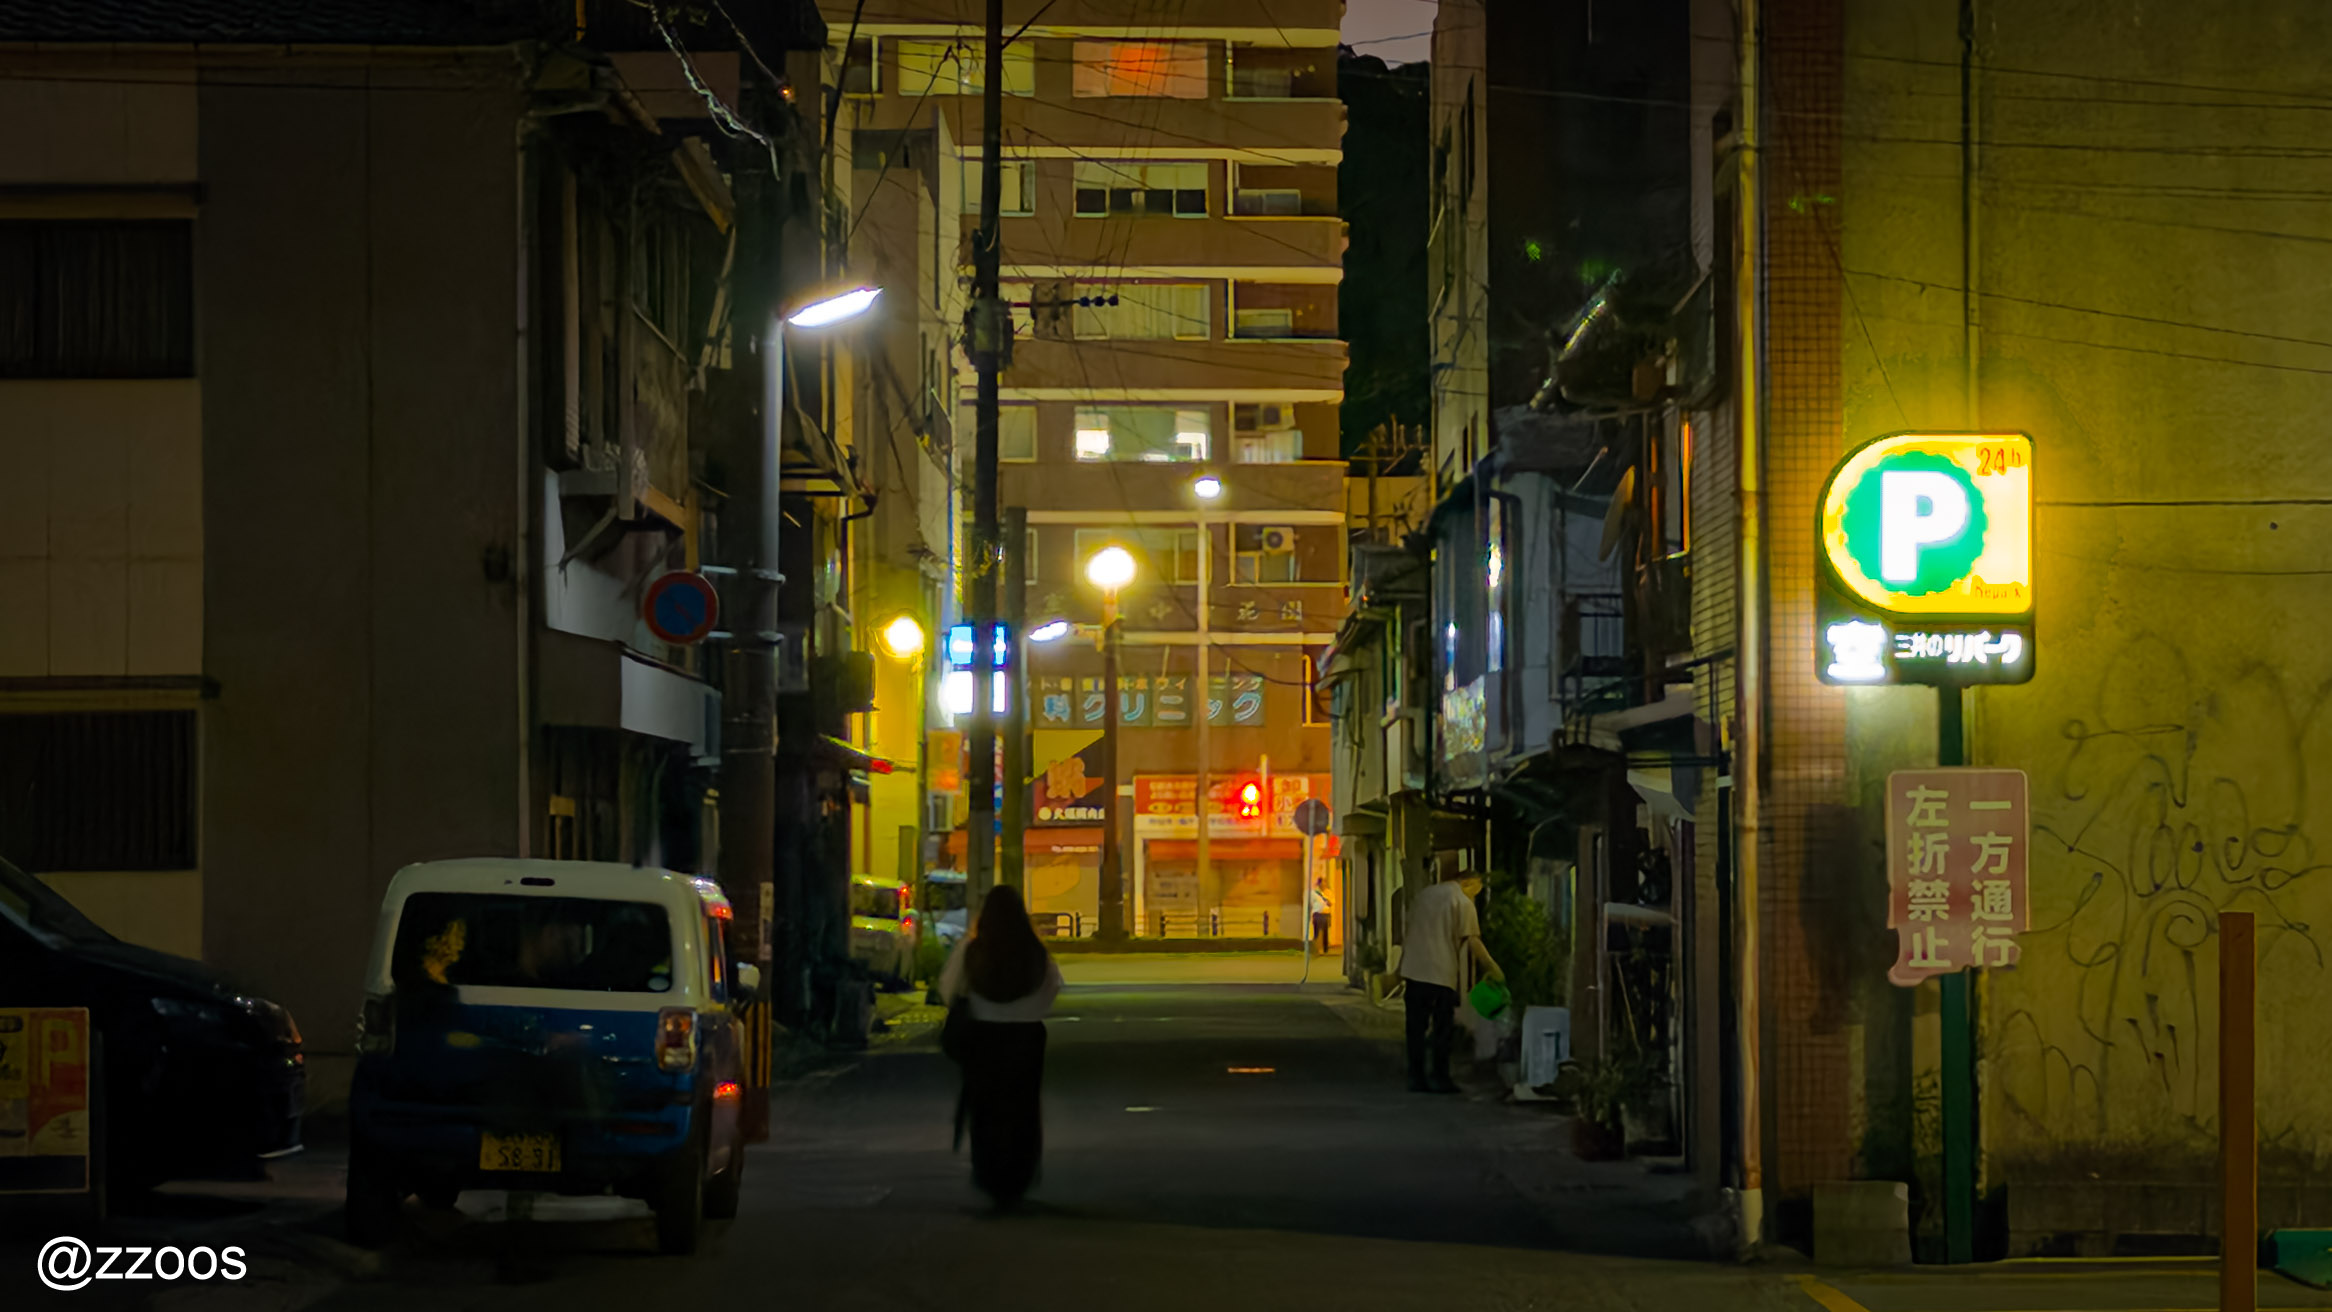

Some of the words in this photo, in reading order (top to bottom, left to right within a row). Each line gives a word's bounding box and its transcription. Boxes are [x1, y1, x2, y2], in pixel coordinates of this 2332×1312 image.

[1881, 470, 1968, 581] P
[1905, 784, 1952, 968] 左折禁止
[1969, 800, 2016, 967] 一方通行
